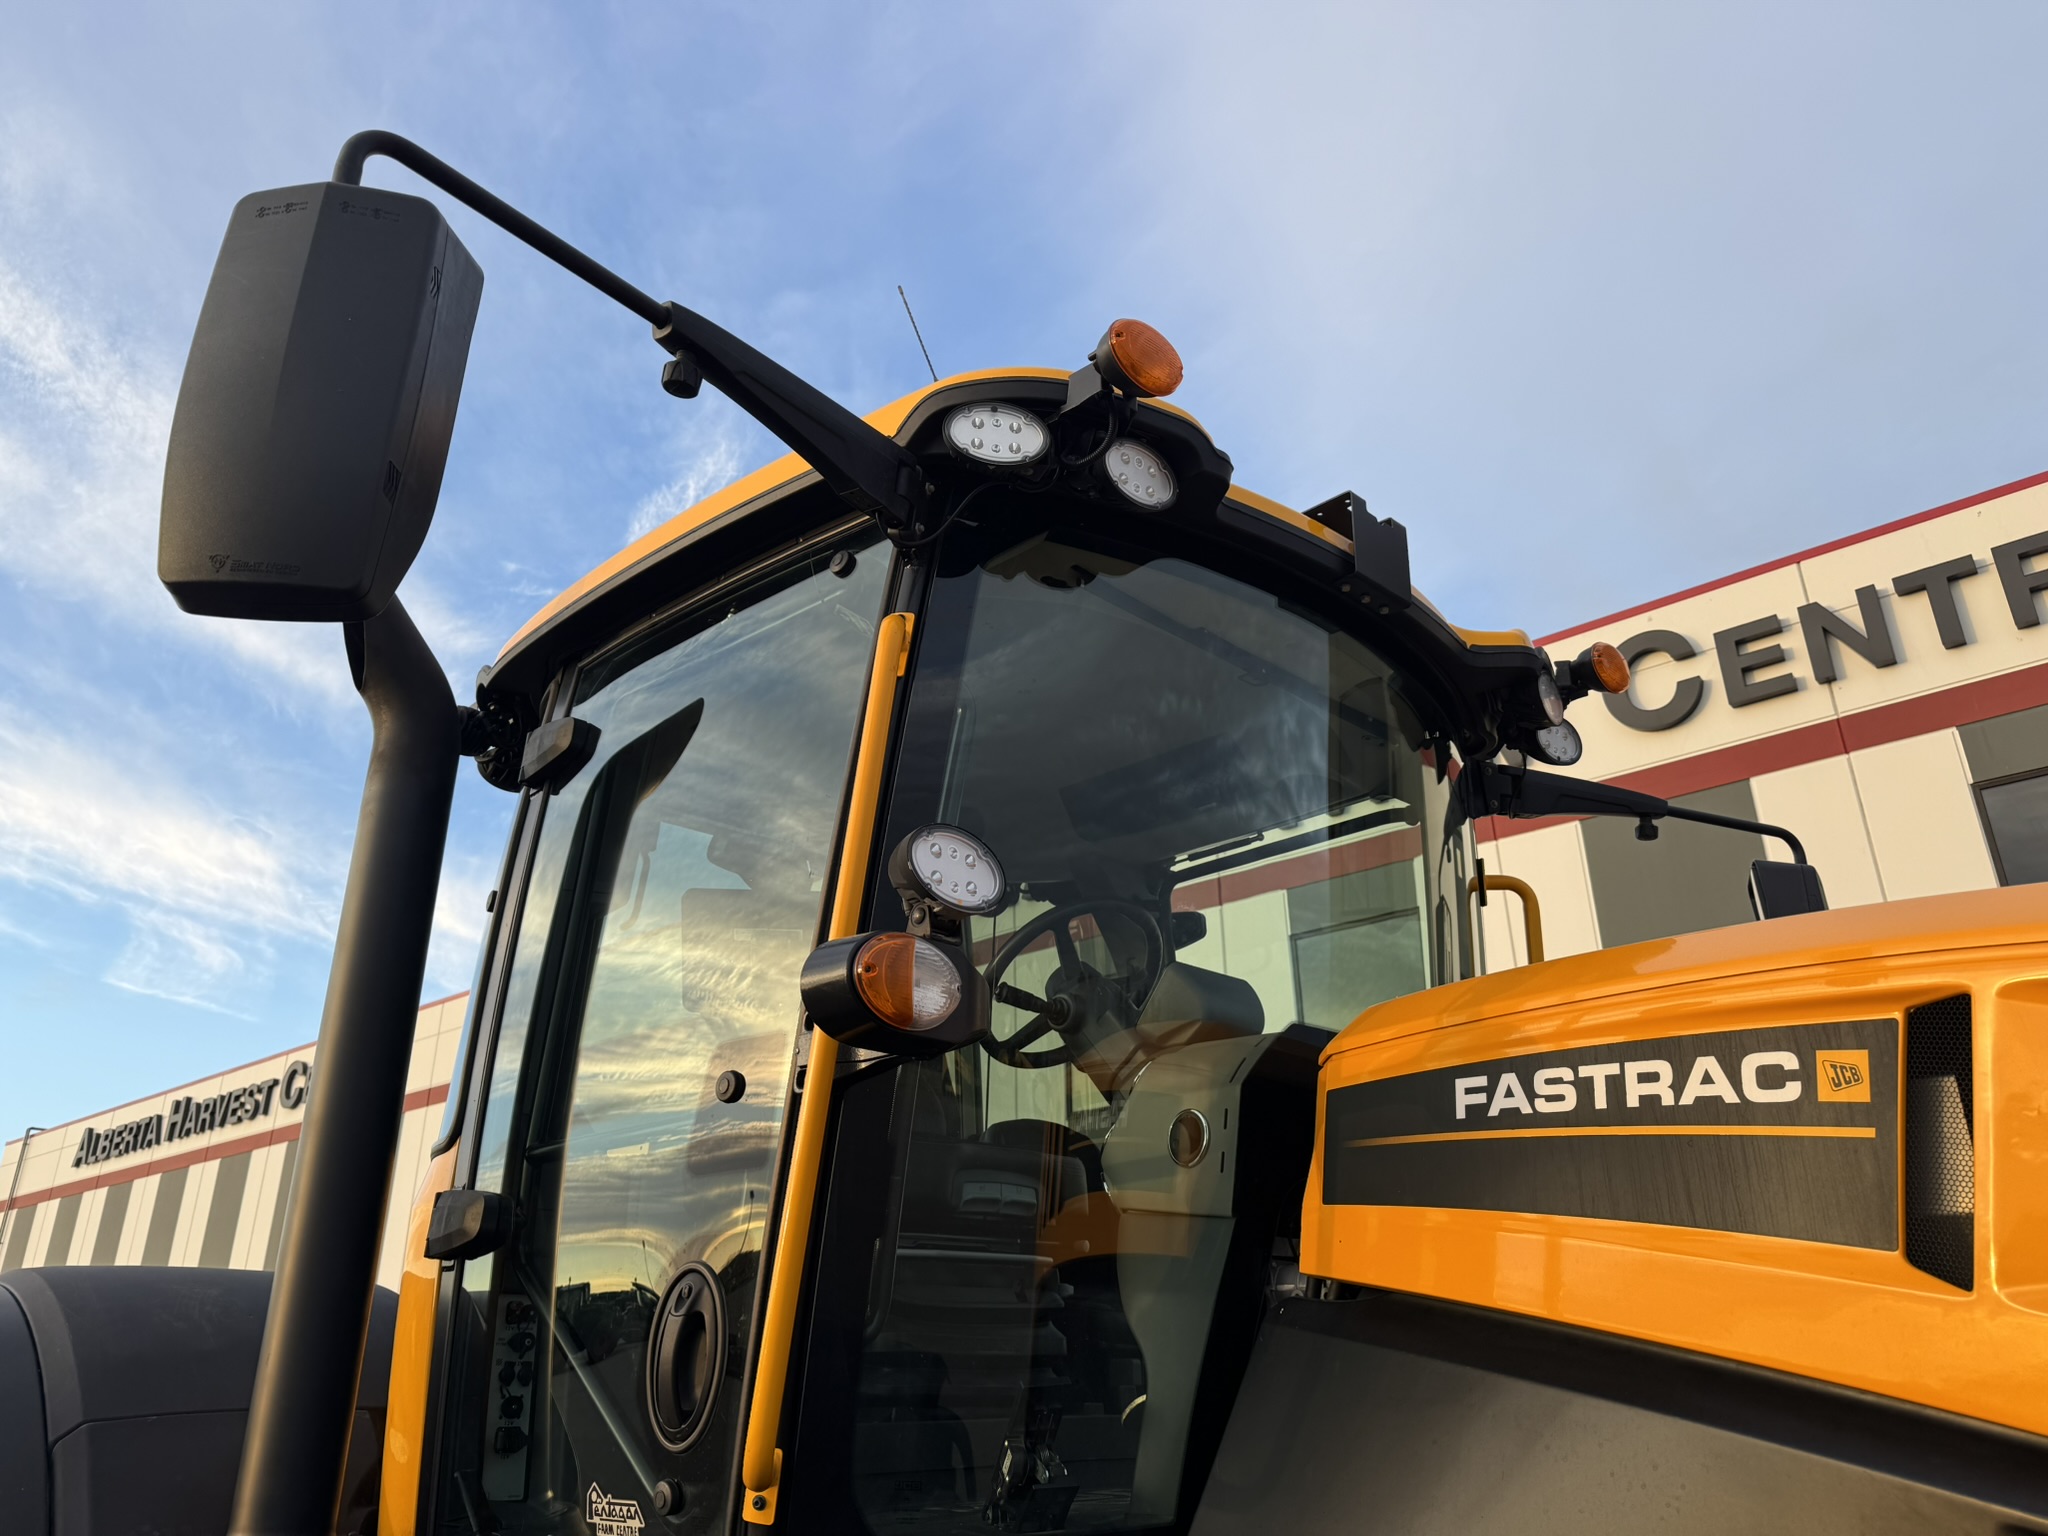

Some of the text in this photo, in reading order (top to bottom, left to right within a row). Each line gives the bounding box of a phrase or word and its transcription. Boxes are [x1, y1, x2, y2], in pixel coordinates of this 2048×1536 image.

[1455, 1051, 1802, 1120] FASTRAC
[1829, 1063, 1861, 1088] JCB
[71, 1060, 313, 1168] ALBERTA HARVEST C
[597, 1523, 637, 1536] FARM CENTRE
